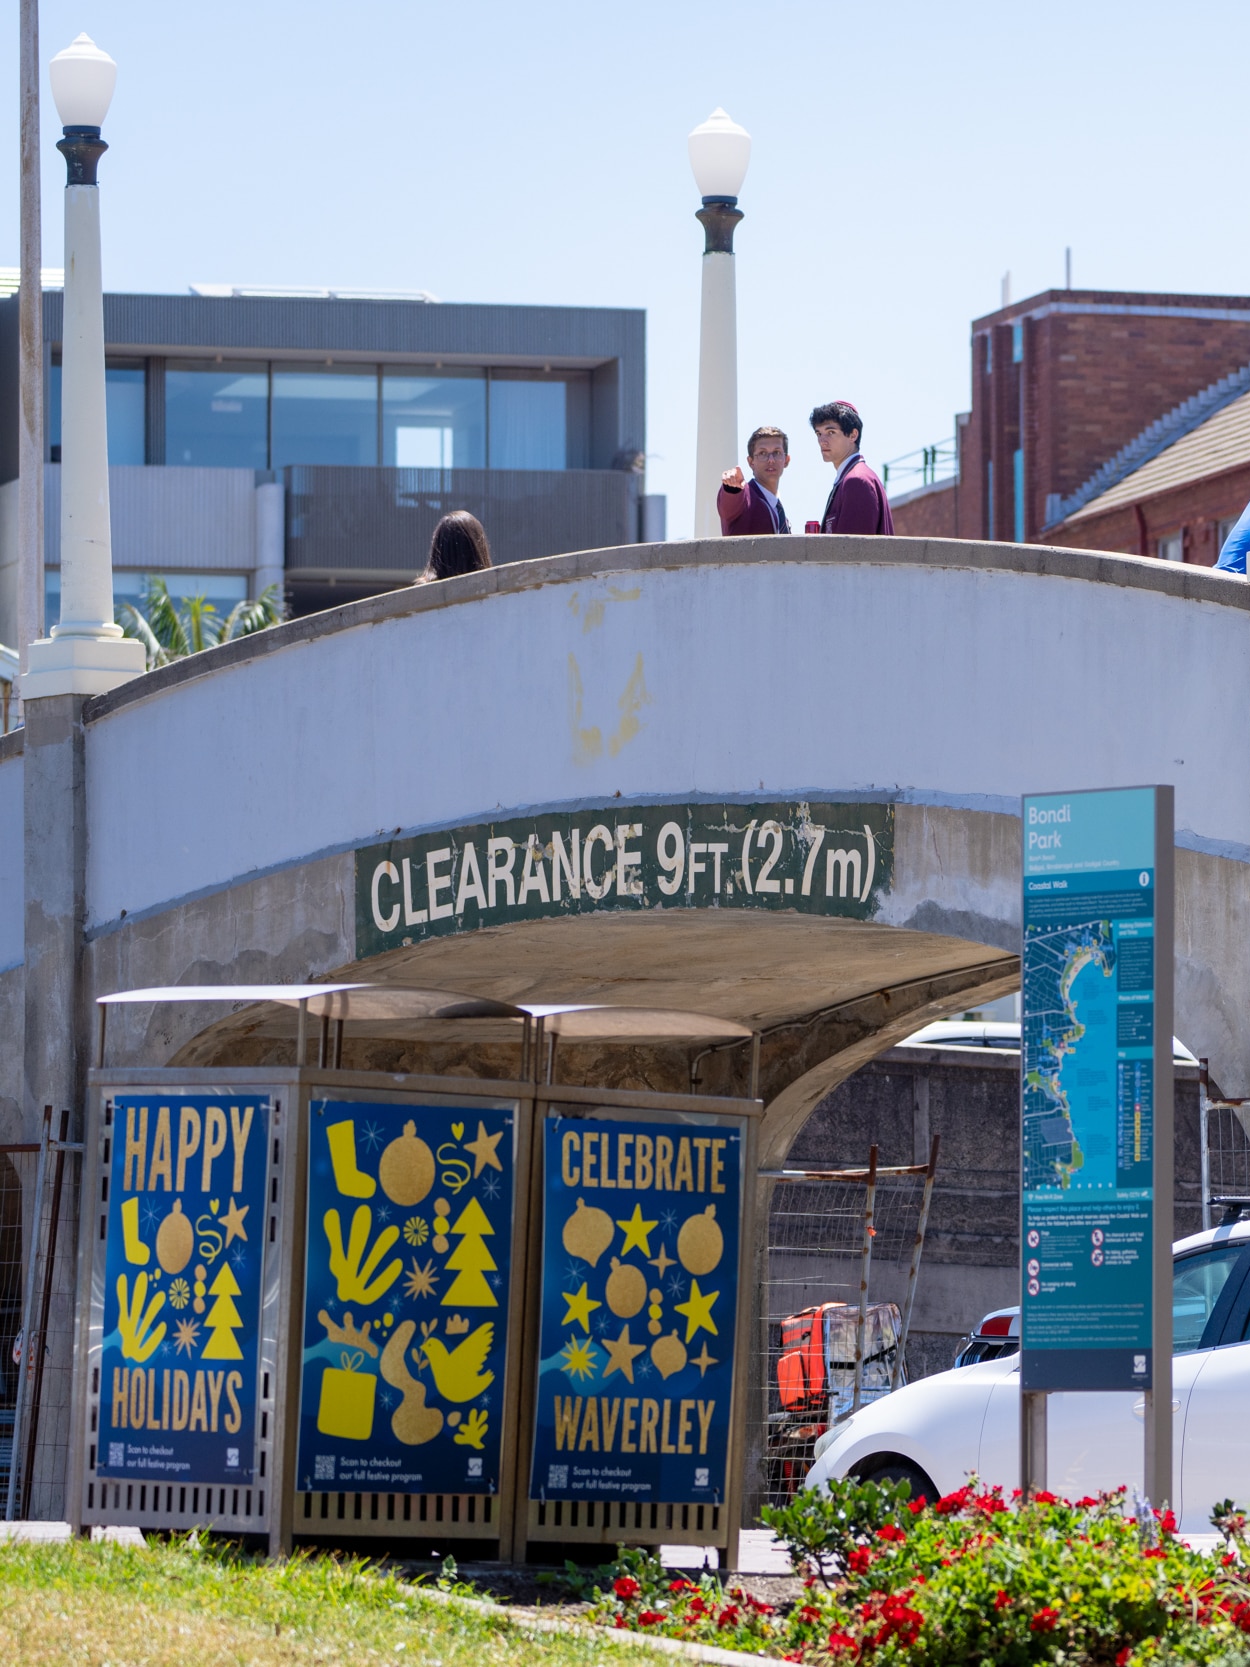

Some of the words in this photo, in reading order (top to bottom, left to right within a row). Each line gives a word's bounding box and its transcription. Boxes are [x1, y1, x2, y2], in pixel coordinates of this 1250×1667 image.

[1029, 804, 1071, 824] Bondi
[1029, 830, 1062, 850] Park
[371, 822, 644, 932] CLEARANCE
[741, 819, 876, 902] (2.7m)
[1028, 881, 1051, 890] Coastal
[1053, 880, 1068, 889] Walk
[123, 1107, 254, 1192] HAPPY
[562, 1131, 726, 1193] CELEBRATE
[111, 1367, 243, 1434] HOLIDAYS
[554, 1395, 716, 1455] WAVERLEY
[128, 1444, 141, 1454] Scan
[142, 1446, 149, 1454] to
[149, 1444, 174, 1456] checkout
[138, 1457, 147, 1468] full
[147, 1457, 165, 1469] festive
[165, 1461, 191, 1472] program
[340, 1456, 359, 1467] Scan
[360, 1458, 368, 1467] to
[369, 1456, 402, 1468] checkout
[339, 1472, 353, 1480] our
[354, 1469, 366, 1480] full
[367, 1469, 390, 1481] festive
[391, 1473, 422, 1484] program
[573, 1465, 591, 1476] Scan
[592, 1467, 600, 1476] to
[600, 1465, 632, 1477] checkout
[571, 1481, 585, 1489] our
[586, 1478, 597, 1490] full
[598, 1479, 620, 1490] festive
[621, 1483, 652, 1493] program
